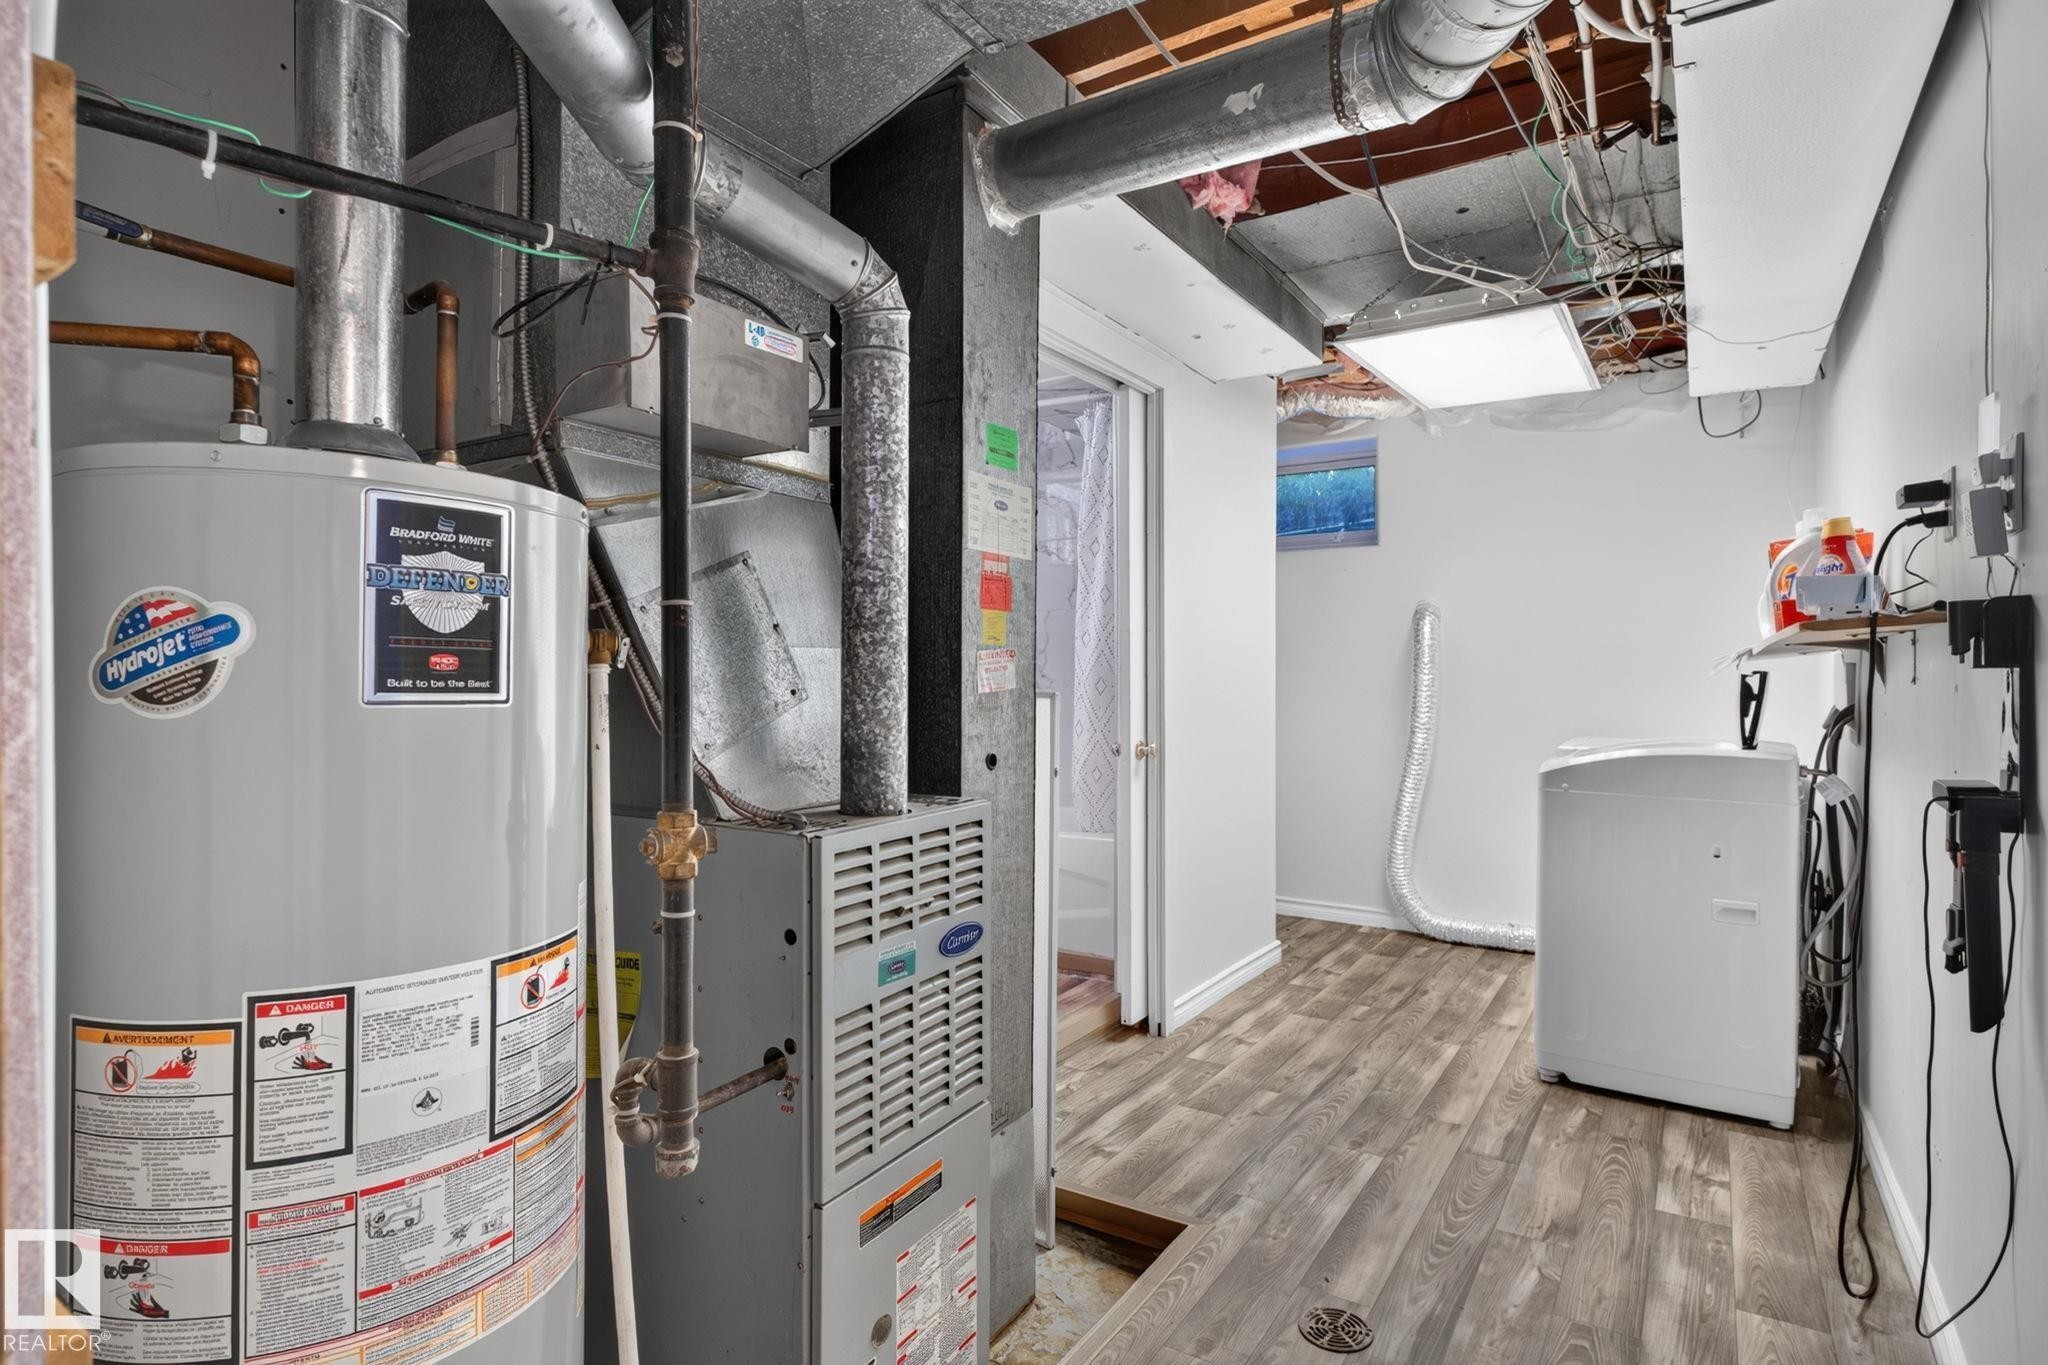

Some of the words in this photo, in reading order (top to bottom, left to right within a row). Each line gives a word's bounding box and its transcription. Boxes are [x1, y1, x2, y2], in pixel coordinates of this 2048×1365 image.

[389, 527, 457, 543] BRADFORD
[458, 533, 495, 548] WHITE
[366, 563, 512, 598] DEFENDER
[106, 631, 187, 683] Hydrojet
[387, 678, 414, 688] Built
[415, 679, 428, 688] to
[430, 679, 446, 688] be
[447, 679, 466, 688] the
[467, 679, 490, 688] Best
[286, 1000, 335, 1013] DANGER
[126, 1244, 169, 1254] DANGER
